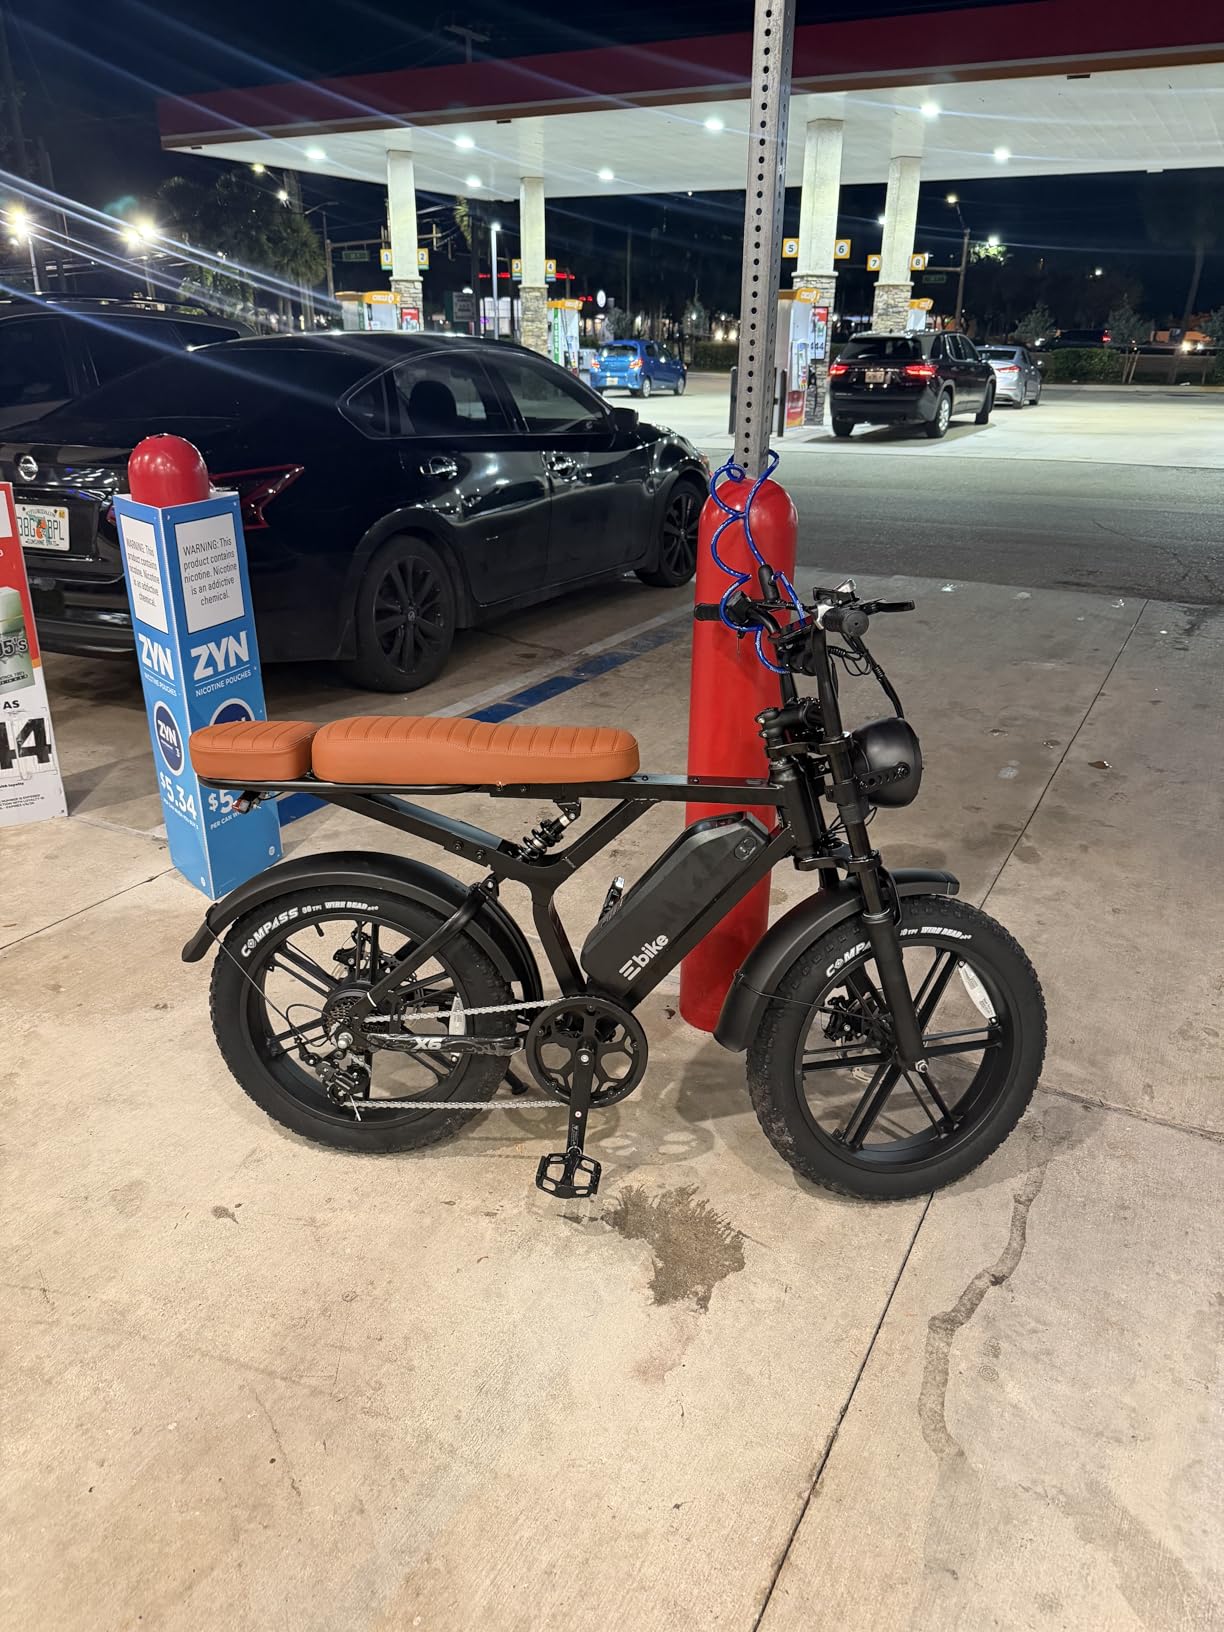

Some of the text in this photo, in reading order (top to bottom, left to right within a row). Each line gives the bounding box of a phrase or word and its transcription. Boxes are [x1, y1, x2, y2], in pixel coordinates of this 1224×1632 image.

[420, 253, 425, 261] 2
[787, 244, 794, 253] 5
[838, 245, 845, 254] 6
[871, 259, 877, 267] 7
[915, 258, 921, 266] 8
[182, 536, 232, 557] WARNING: This
[183, 549, 235, 573] product contains
[184, 562, 238, 584] nicotine. Nicotine
[191, 575, 235, 596] is an addictive
[200, 589, 230, 606] chemical.
[0, 638, 27, 658] 5's
[138, 632, 175, 681] ZYN
[190, 630, 250, 681] ZYN
[195, 669, 252, 697] NICOTINE POUCHES
[3, 700, 20, 710] AS
[157, 719, 178, 747] ZYN
[159, 771, 198, 821] $5.34
[221, 814, 233, 825] CAN
[240, 907, 299, 958] COMPASS
[618, 934, 669, 981] Ebike
[825, 940, 872, 978] COMPA
[413, 1037, 443, 1050] X6
